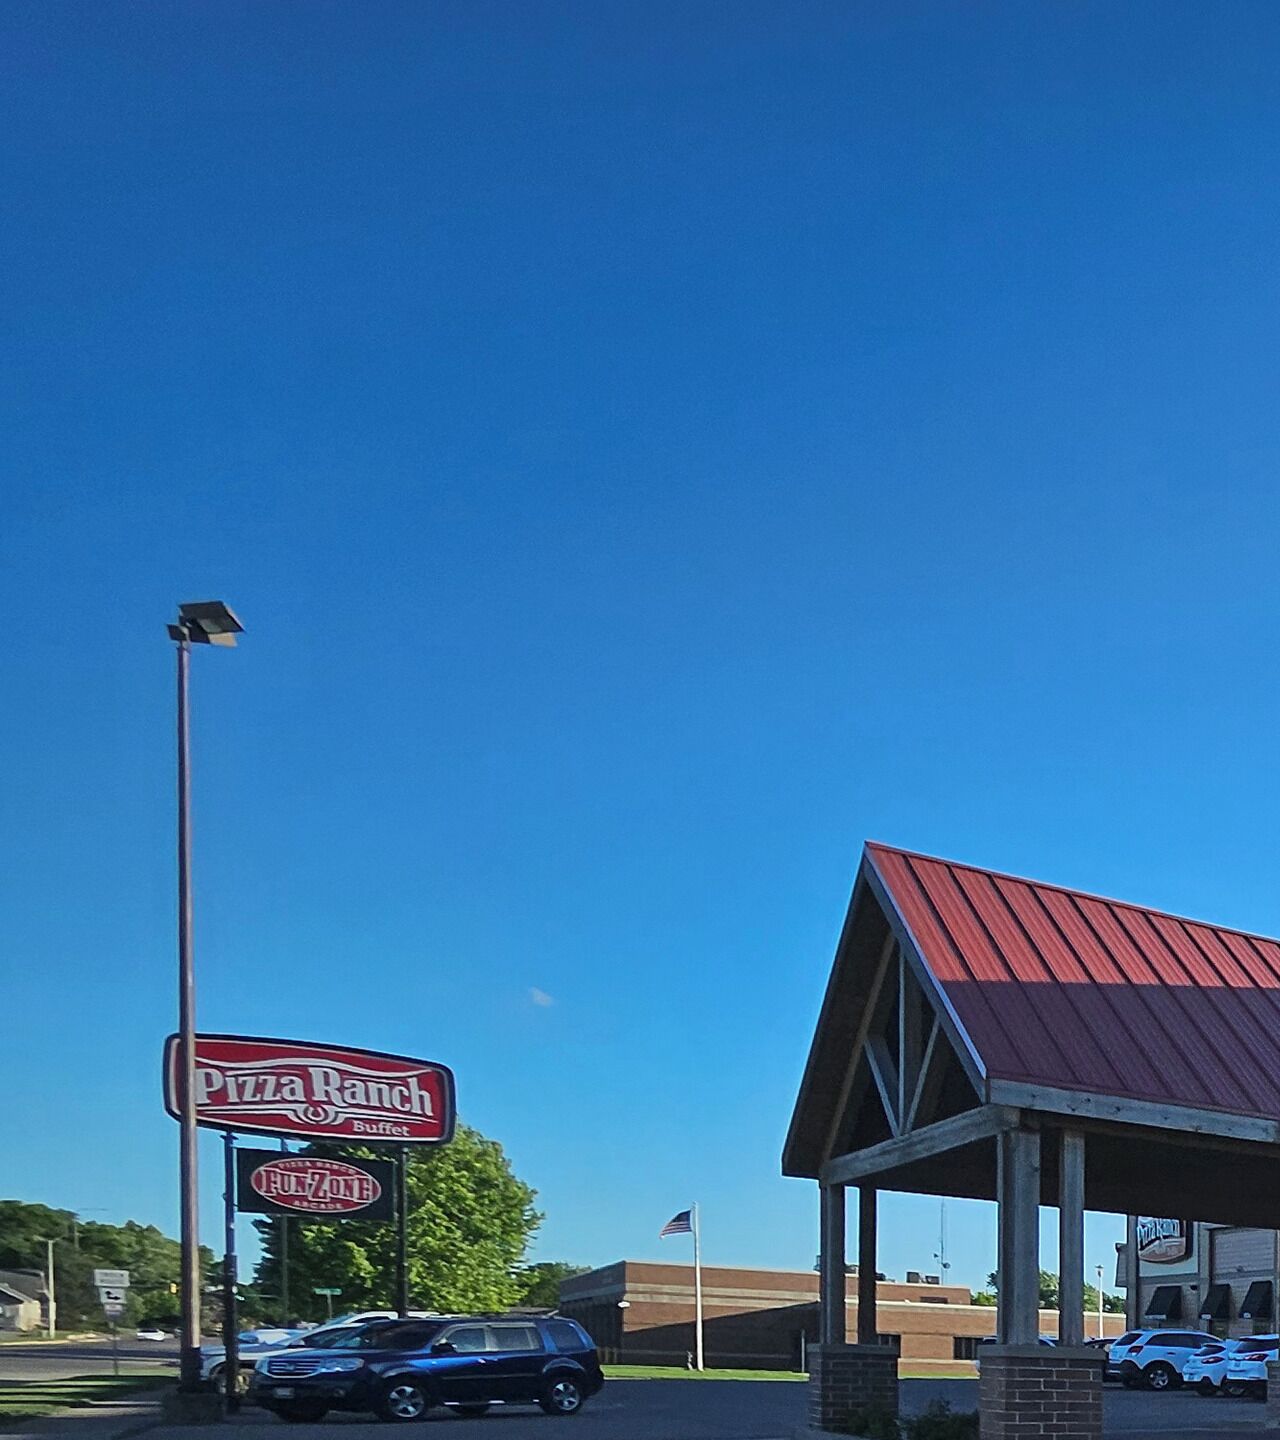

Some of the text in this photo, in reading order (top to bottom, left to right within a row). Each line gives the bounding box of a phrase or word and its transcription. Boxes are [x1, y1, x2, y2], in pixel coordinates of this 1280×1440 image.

[195, 1066, 434, 1116] Pizza Ranch
[352, 1120, 411, 1137] Buffet
[292, 1200, 345, 1210] ARCADE
